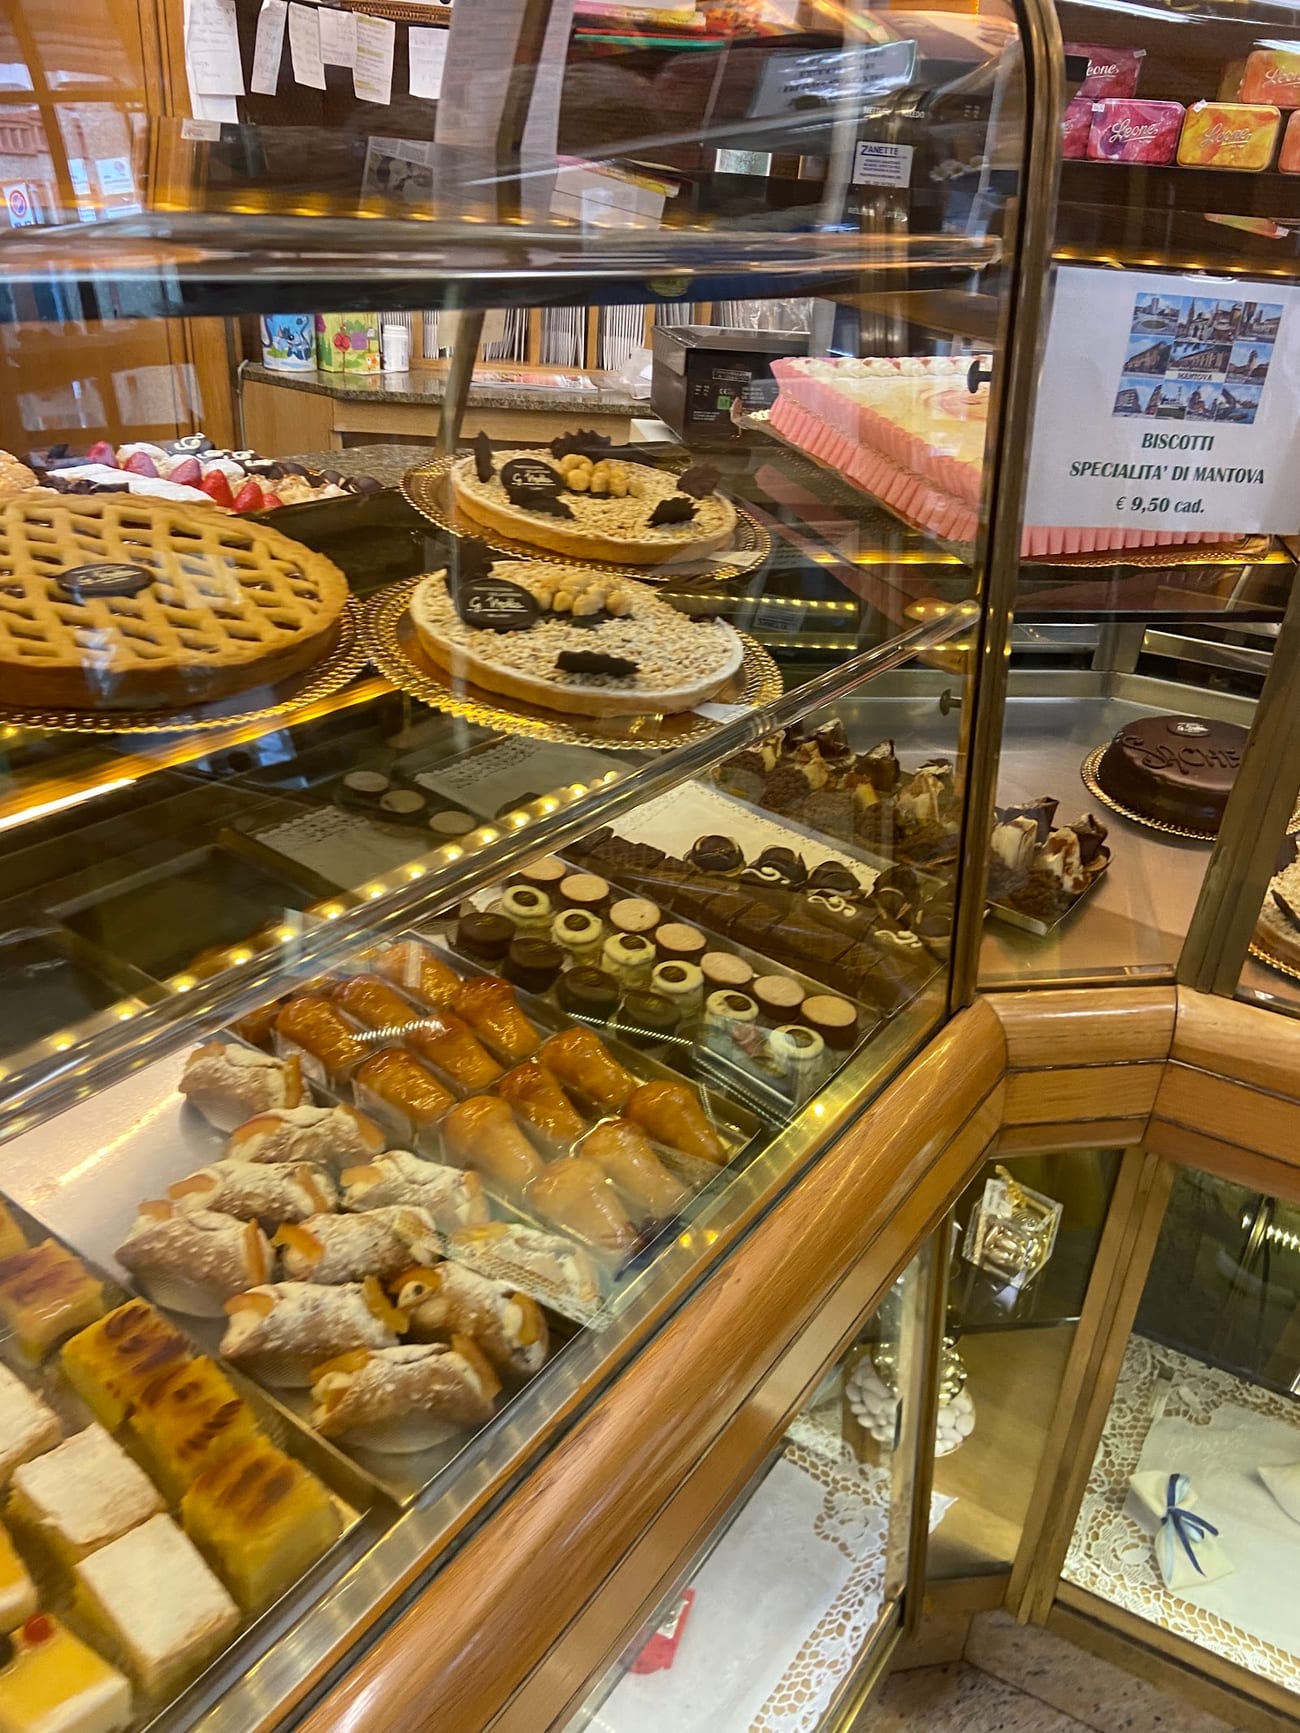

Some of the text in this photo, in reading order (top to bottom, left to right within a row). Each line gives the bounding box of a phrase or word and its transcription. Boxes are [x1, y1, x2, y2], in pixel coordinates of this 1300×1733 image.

[1086, 59, 1119, 77] eone
[1109, 119, 1160, 143] Leone
[1201, 122, 1253, 146] Leone
[1141, 432, 1215, 451] BISCOTTI
[1069, 461, 1265, 484] SPECIALITA' DI MANTOVA
[1116, 496, 1205, 514] € 9,50 cad.
[1121, 735, 1241, 775] SACHE
